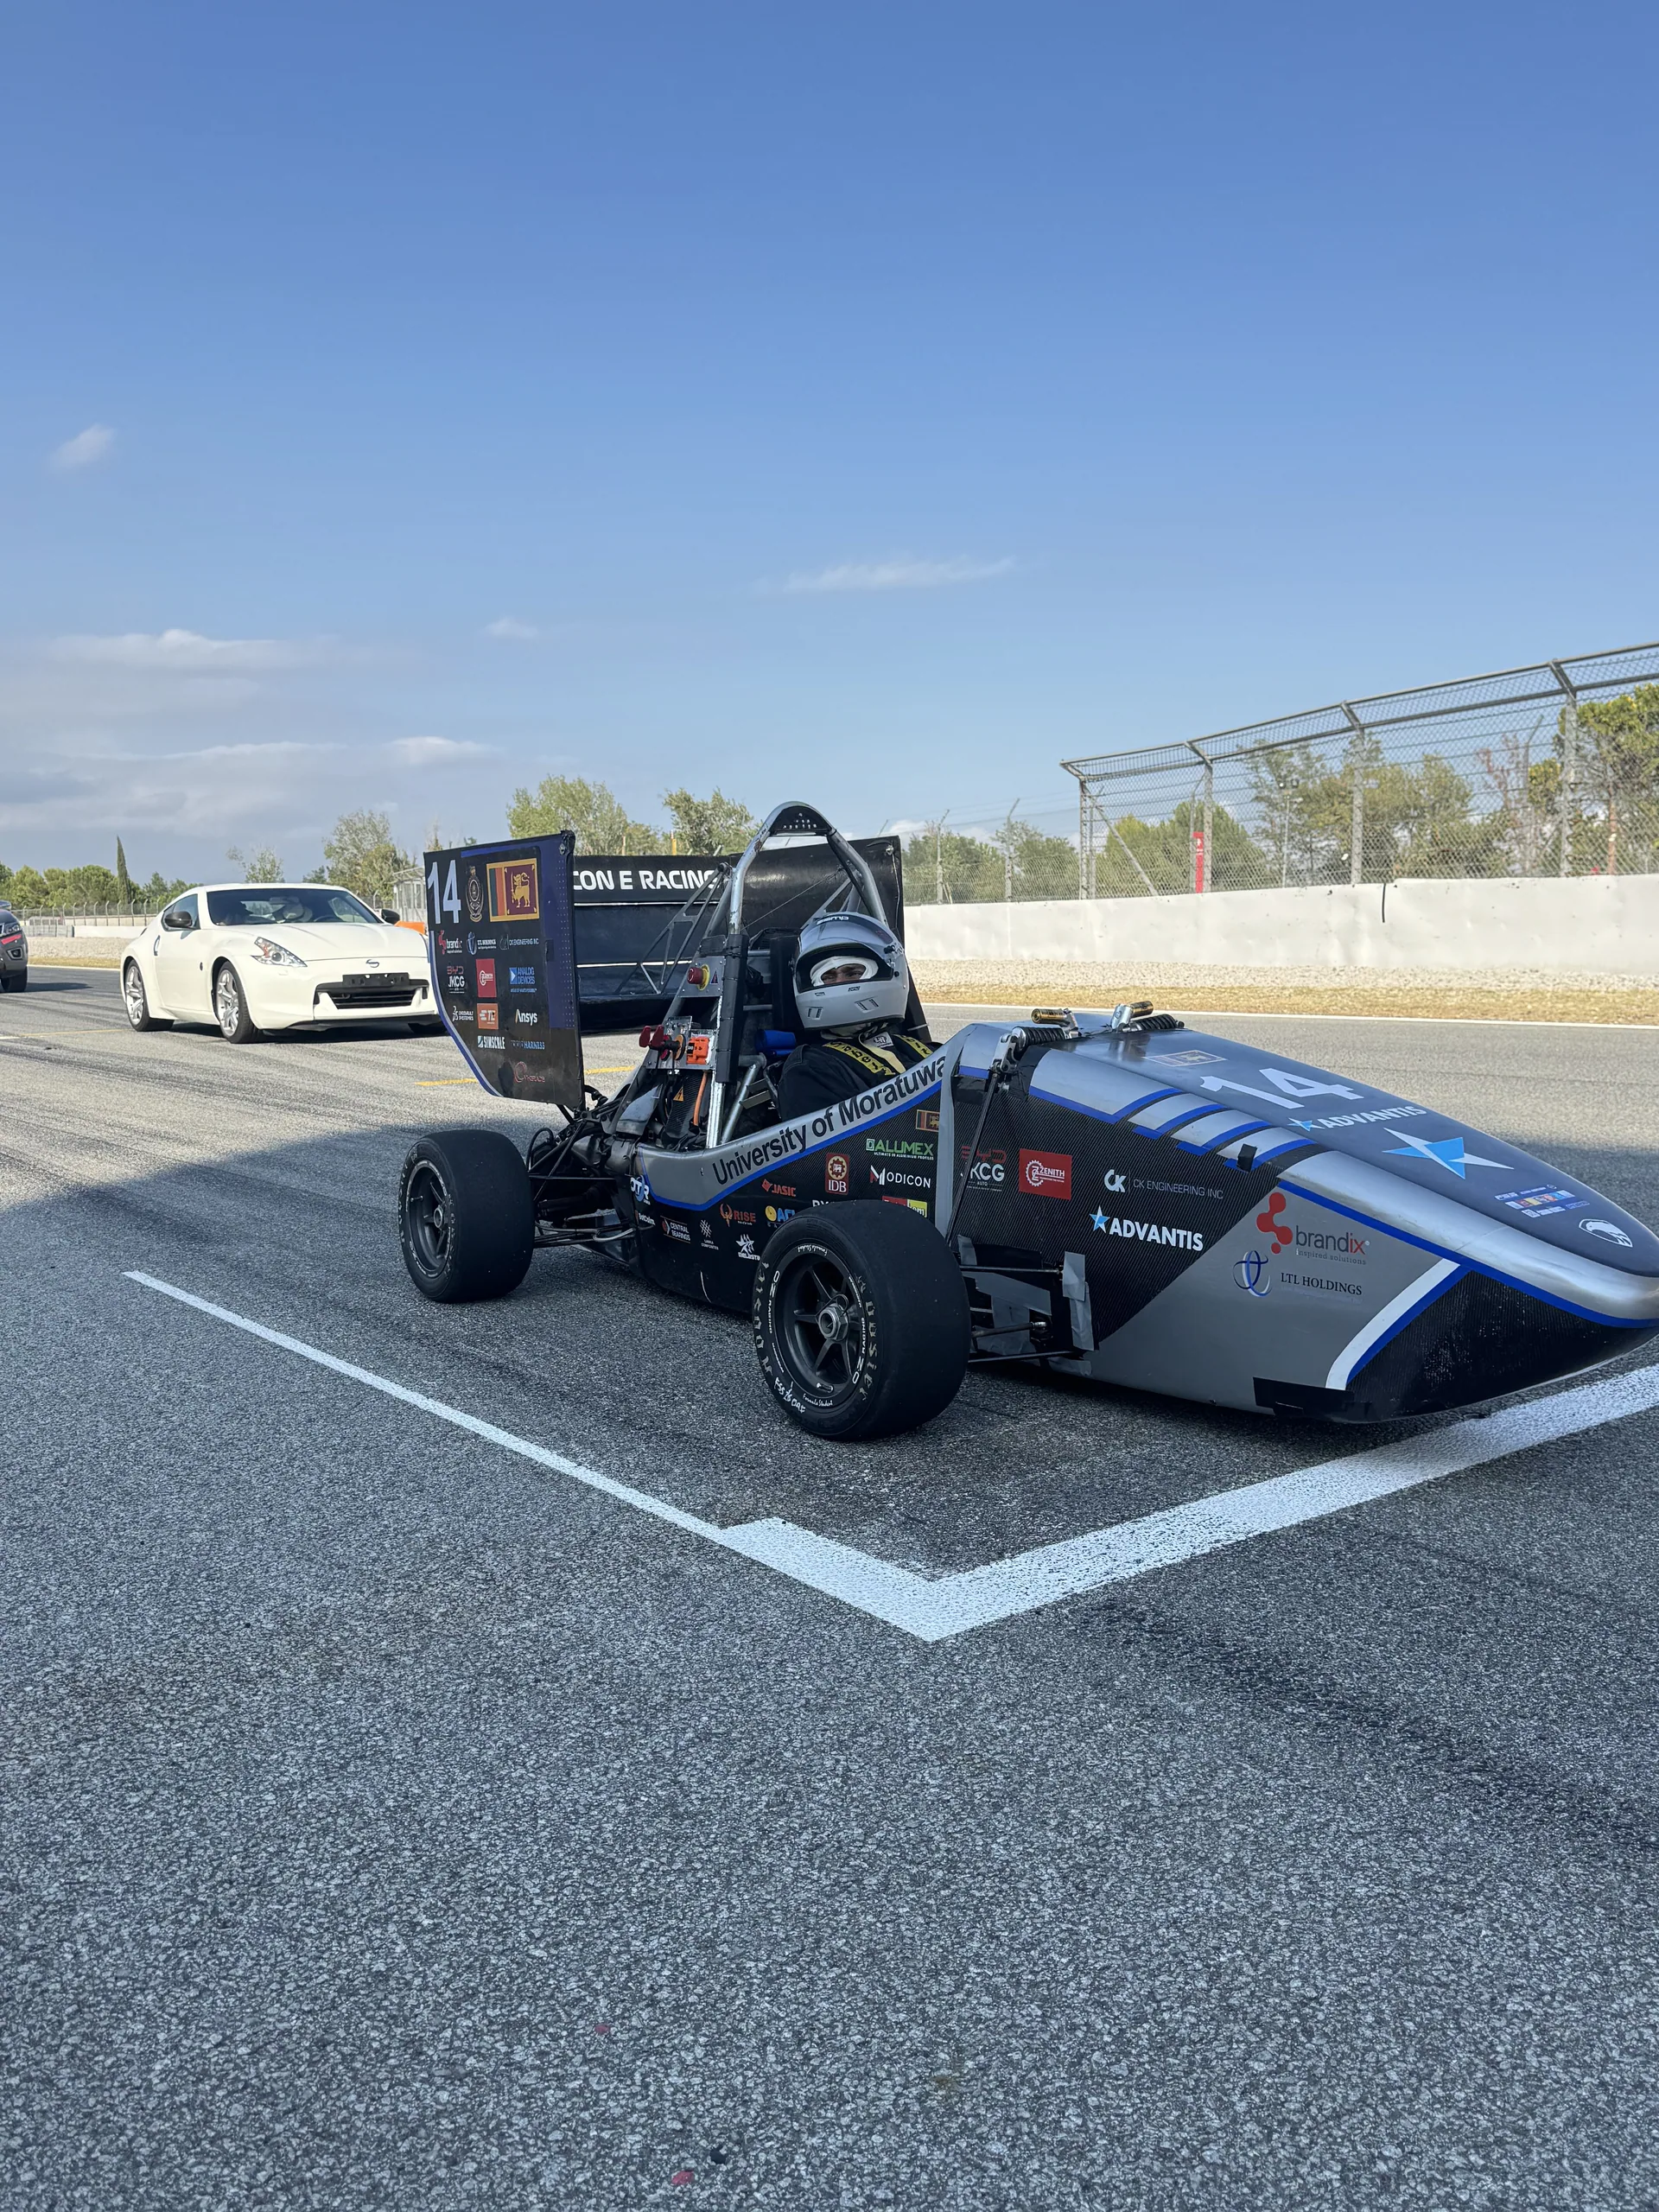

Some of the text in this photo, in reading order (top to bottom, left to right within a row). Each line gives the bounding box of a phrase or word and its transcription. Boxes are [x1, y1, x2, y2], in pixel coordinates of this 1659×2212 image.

[619, 870, 633, 890] E
[639, 870, 719, 890] RACING
[427, 859, 461, 924] 14
[518, 967, 535, 976] ANALOG
[518, 976, 536, 985] DEVICES
[448, 976, 465, 988] JKCG
[515, 1008, 537, 1027] Ansys
[1199, 1068, 1364, 1109] 14
[712, 1055, 946, 1185] University of Moratuwa
[1316, 1105, 1427, 1128] ADVANTIS
[874, 1140, 933, 1156] ALUMEX
[969, 1161, 1005, 1182] KCG
[1039, 1166, 1065, 1178] ZENITH
[828, 1179, 847, 1193] IDB
[1133, 1179, 1224, 1199] CK ENGINEERING INC
[734, 1211, 757, 1223] RISE
[670, 1221, 690, 1234] CENTRAL
[1109, 1217, 1204, 1251] ADVANTIS
[1295, 1224, 1366, 1255] brandix
[1295, 1249, 1367, 1265] inspired solutions
[1281, 1273, 1300, 1285] LTL
[1302, 1275, 1363, 1296] HOLDINGS
